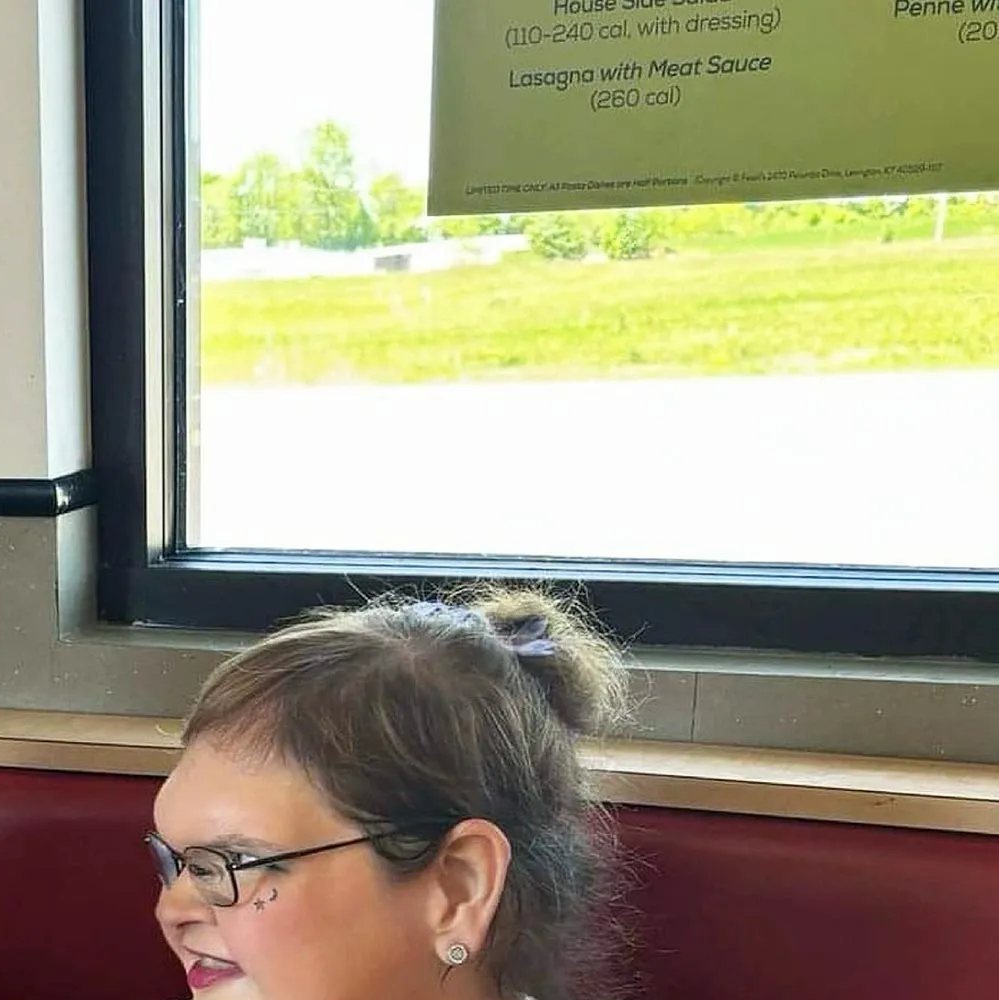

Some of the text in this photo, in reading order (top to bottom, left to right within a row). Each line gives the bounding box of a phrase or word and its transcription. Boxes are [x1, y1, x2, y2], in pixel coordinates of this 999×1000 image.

[554, 0, 616, 15] House
[895, 0, 999, 18] Penne wi
[505, 24, 594, 48] (110-240
[637, 16, 680, 35] with
[685, 5, 781, 34] dressing)
[509, 55, 773, 91] Lasagna with Meat Sauce
[590, 86, 682, 112] (260 cal)
